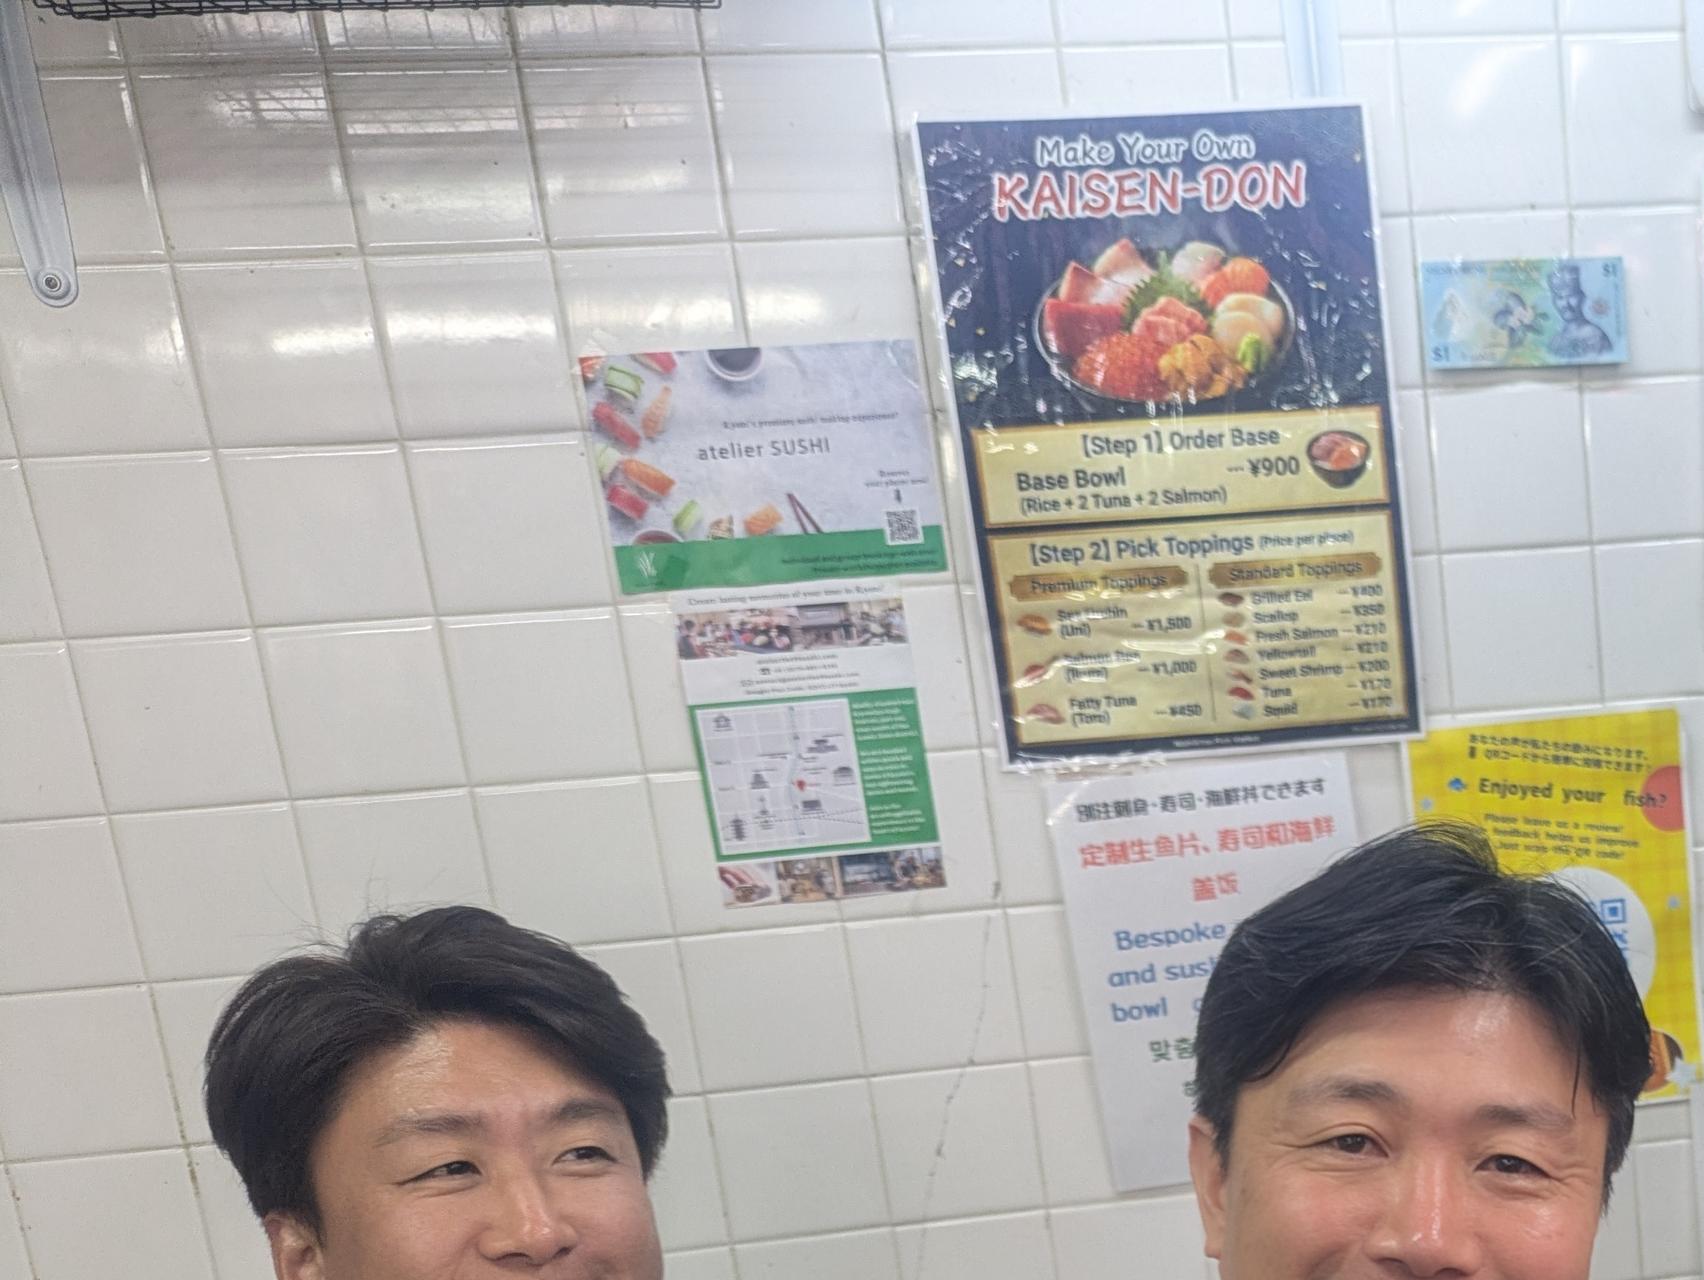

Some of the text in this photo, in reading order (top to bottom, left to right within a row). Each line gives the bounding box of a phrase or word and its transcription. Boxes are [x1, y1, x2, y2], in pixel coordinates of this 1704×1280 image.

[1037, 129, 1255, 167] Make Your Own
[992, 161, 1306, 221] KAISEN-DON
[697, 437, 831, 462] atelier SUSHI
[1171, 430, 1227, 451] Order
[1232, 428, 1281, 448] Base
[1249, 456, 1300, 477] ¥900
[1017, 466, 1126, 492] Base Bowl
[1020, 494, 1060, 516] (Rice
[1078, 493, 1088, 511] 2
[1092, 490, 1130, 510] Tuna
[1148, 489, 1159, 507] 2
[1162, 486, 1227, 506] Salmon)
[1116, 537, 1160, 558] Pick
[1164, 532, 1254, 560] Toppings
[1259, 533, 1293, 550] (Price
[1296, 533, 1317, 547] per
[1230, 560, 1363, 582] Standard Toppings
[1031, 573, 1168, 593] Premium Toppings
[1254, 610, 1298, 626] Scallop
[1060, 623, 1091, 640] (Uni)
[1256, 627, 1338, 643] Fresh Salmon
[1259, 663, 1343, 681] Sweet Shrimp
[1070, 695, 1137, 712] Fatty Tuna
[1261, 685, 1292, 699] Tuna
[1264, 703, 1298, 719] Squid
[1479, 778, 1667, 809] Enjoyed your fish?
[1114, 923, 1227, 951] Bespoke
[1108, 963, 1157, 988] and
[1110, 997, 1169, 1022] bowl
